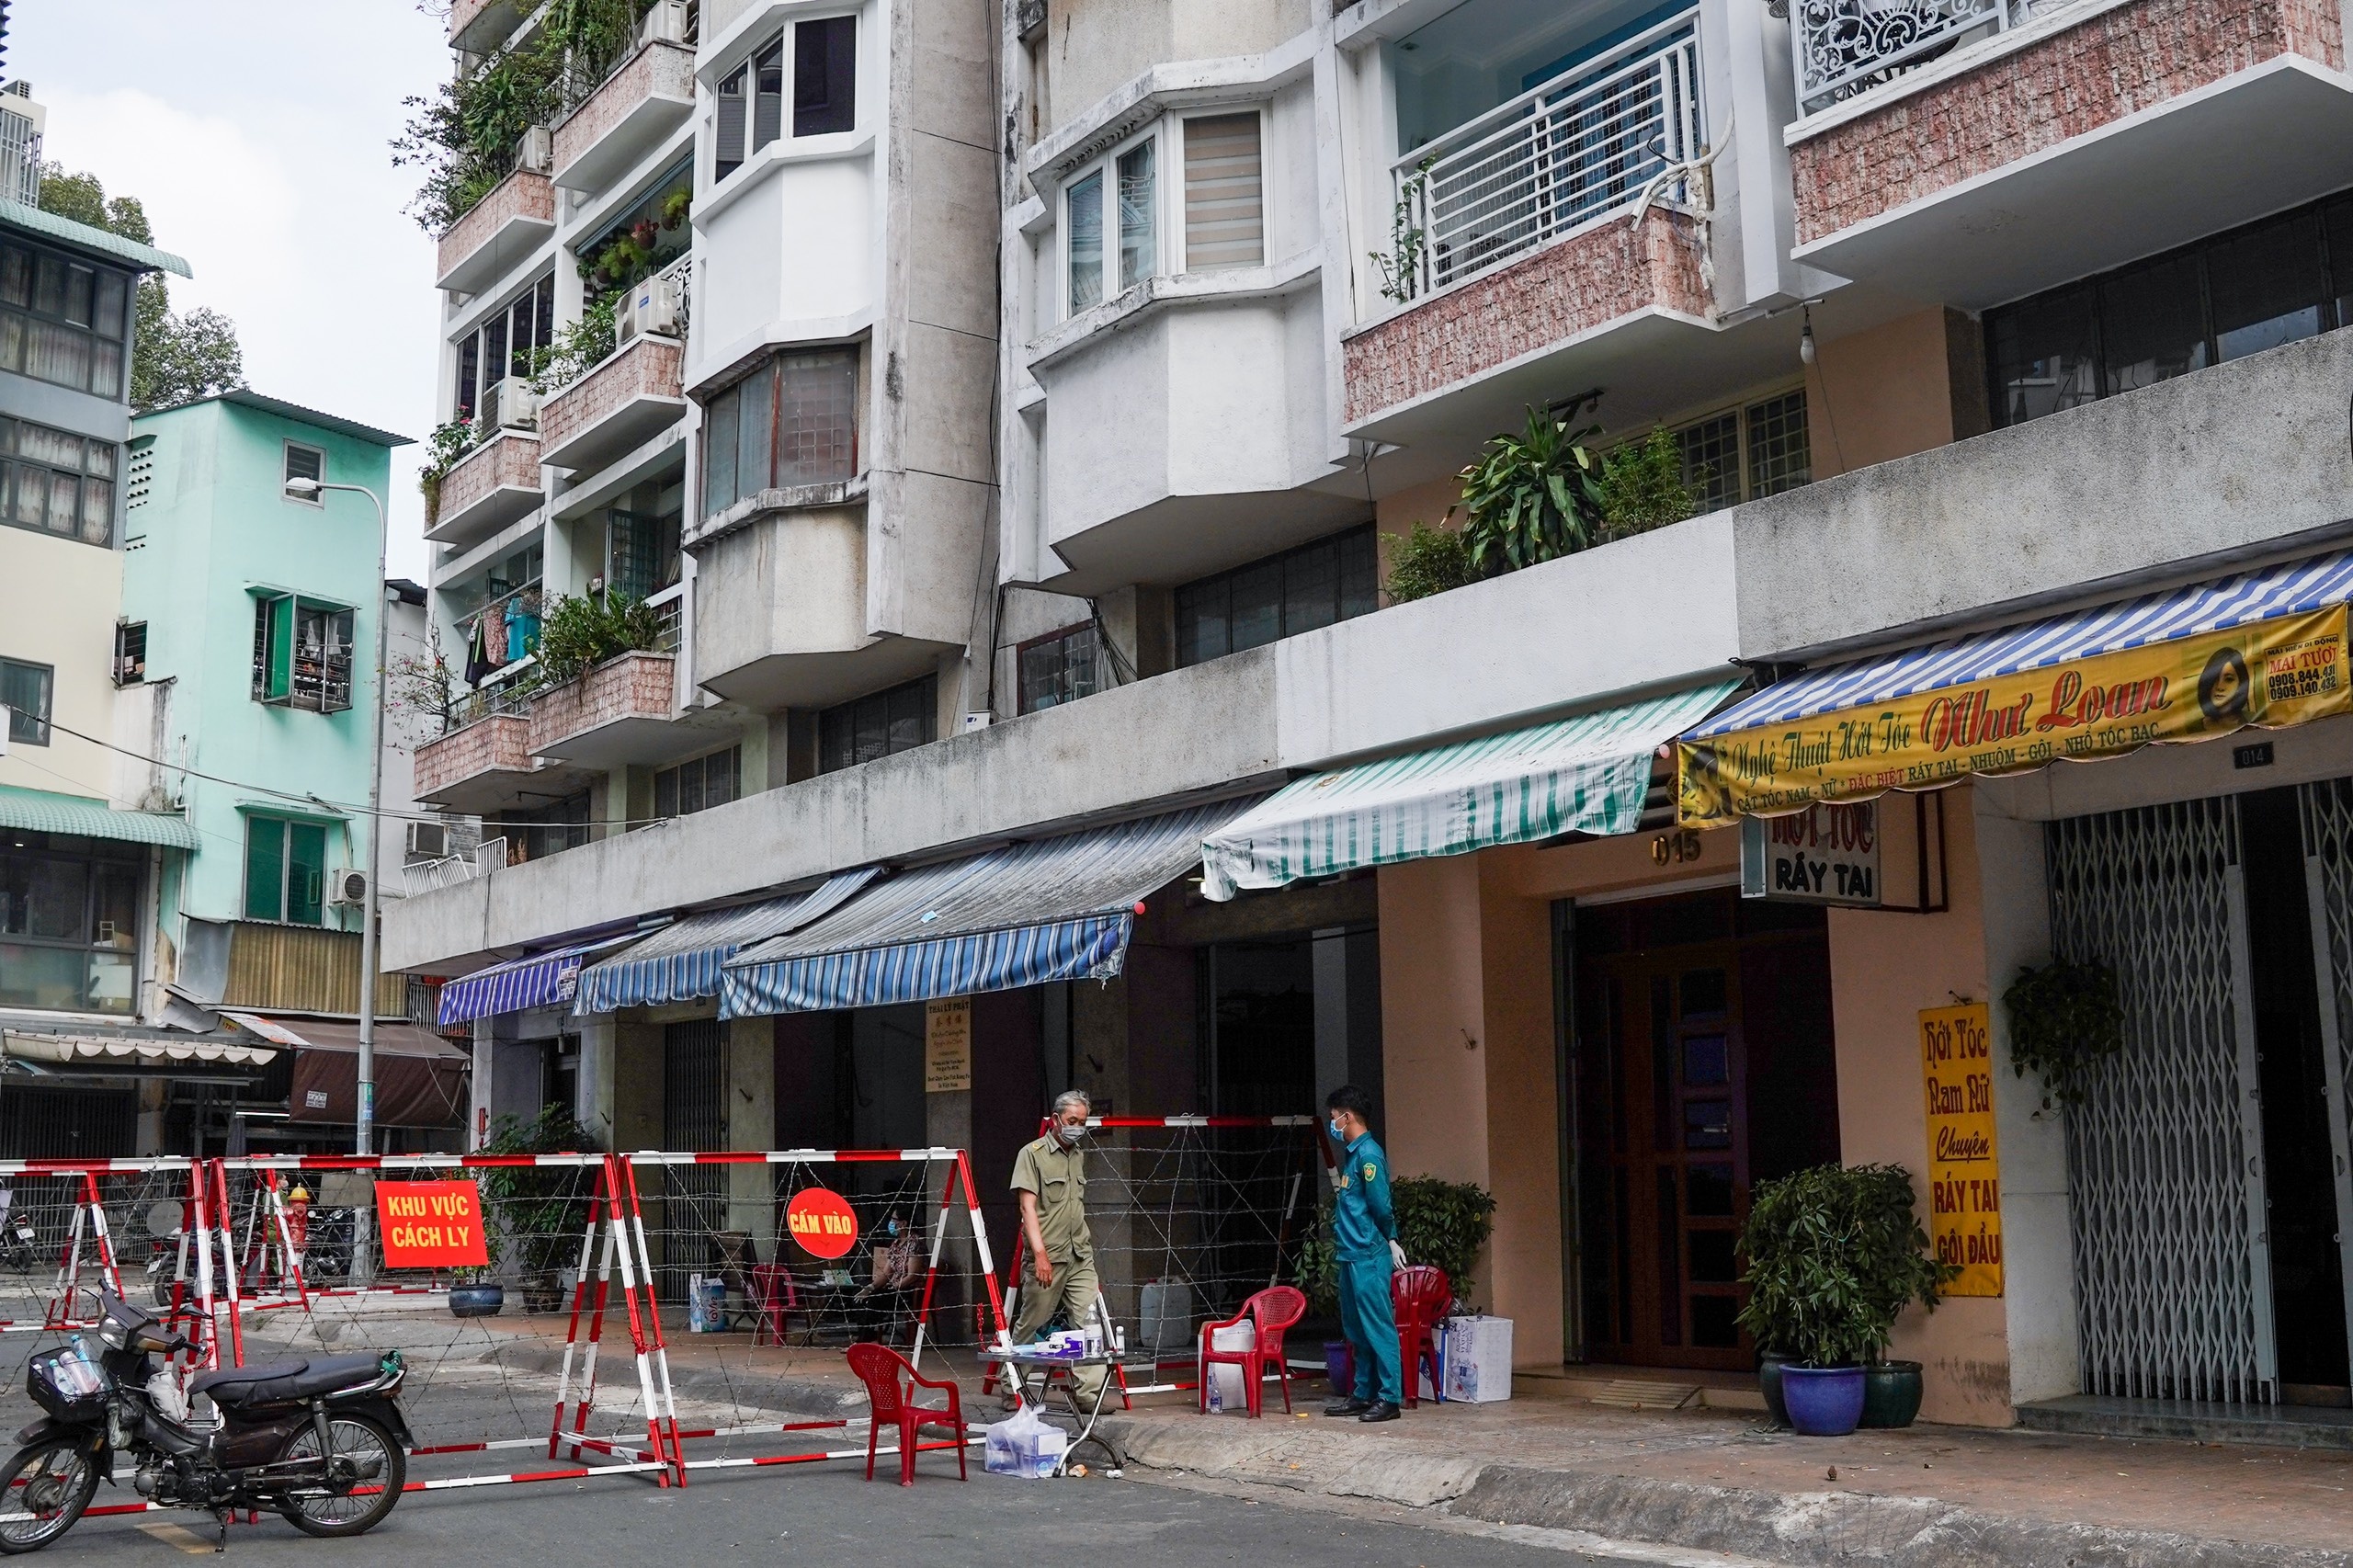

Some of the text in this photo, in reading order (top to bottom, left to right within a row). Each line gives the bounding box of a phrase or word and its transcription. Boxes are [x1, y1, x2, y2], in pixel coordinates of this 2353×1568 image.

[2268, 664, 2336, 687] 0908.844.431
[2269, 645, 2337, 674] MAI TƯƠI
[2270, 676, 2336, 699] 0909.140.432
[1920, 670, 2174, 752] Như Loan
[1733, 711, 1912, 787] Nghệ Thuật Hớt Tóc
[1737, 790, 1757, 812] CẮT
[1761, 789, 1783, 808] TÓC
[1786, 787, 1811, 803] NAM
[1821, 778, 1837, 797] NỮ
[1908, 761, 1933, 781] RÁY
[1937, 759, 1959, 776] TAI
[1970, 746, 2016, 770] NHUỘM
[2029, 739, 2052, 761] GỘI
[2064, 724, 2093, 753] NHỔ
[2097, 726, 2126, 746] TÓC
[2242, 748, 2264, 765] 014
[1652, 829, 1700, 866] 015
[1776, 851, 1872, 898] RÁY TAI
[1925, 1017, 1987, 1069] Hớt Tóc
[1928, 1073, 1990, 1115] Nam Nữ
[1936, 1125, 1990, 1164] Chuyên
[387, 1192, 469, 1221] KHU VỰC
[1934, 1171, 1998, 1213] RÁY TAI
[392, 1221, 469, 1247] CÁCH LY
[790, 1209, 852, 1234] CẤM VÀO
[1968, 1221, 2000, 1265] ĐẦU
